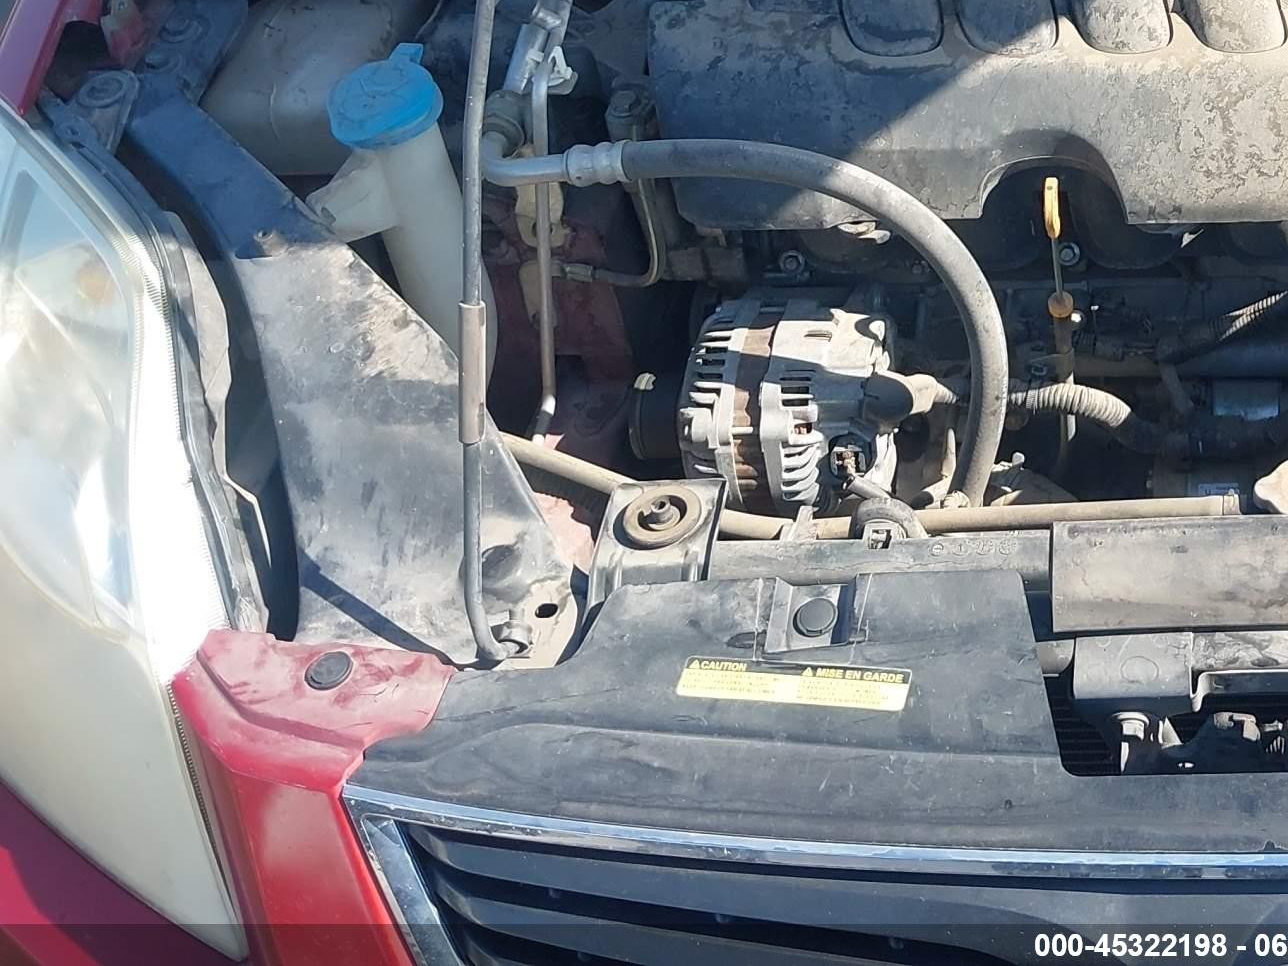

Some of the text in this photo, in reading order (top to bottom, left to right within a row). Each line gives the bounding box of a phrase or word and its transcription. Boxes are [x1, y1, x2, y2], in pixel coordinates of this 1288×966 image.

[700, 660, 748, 672] CAUTION
[815, 667, 905, 683] MISE EN GARDE
